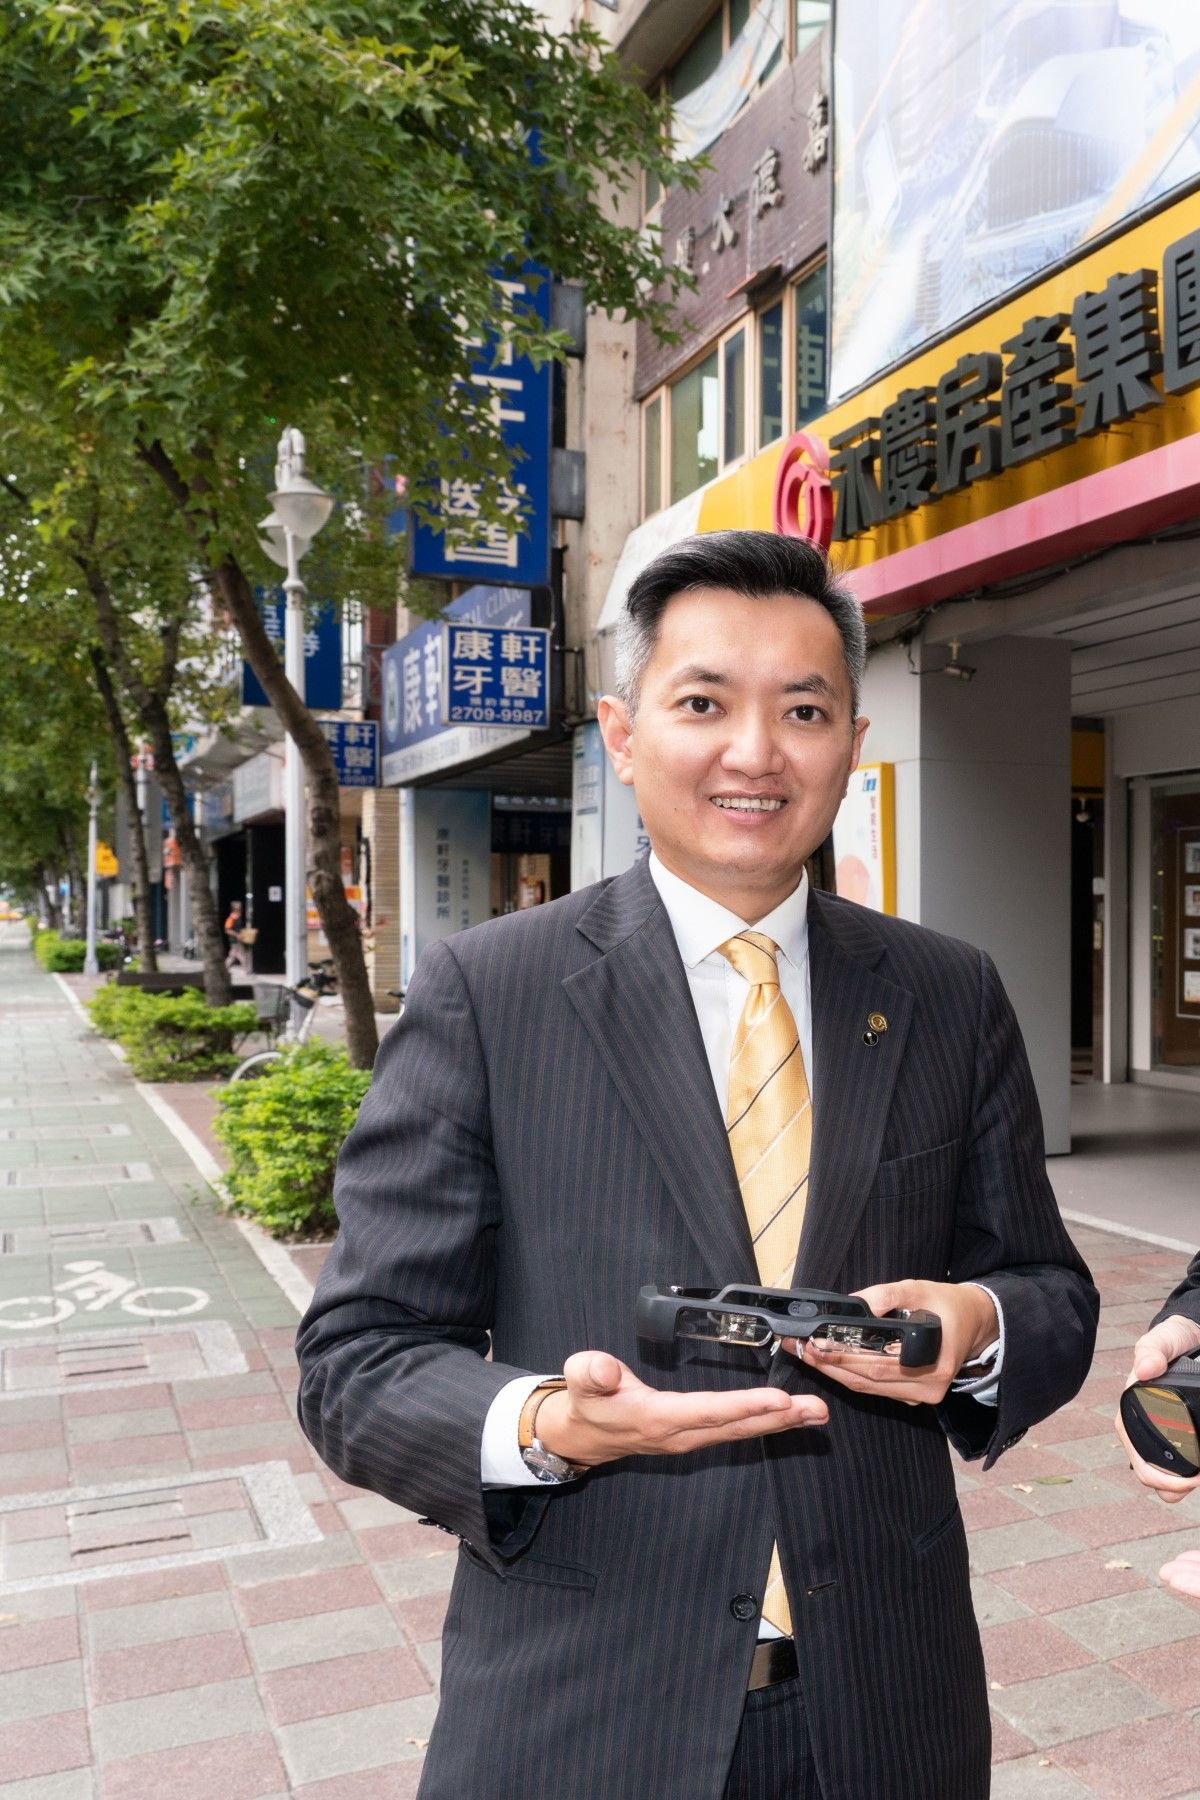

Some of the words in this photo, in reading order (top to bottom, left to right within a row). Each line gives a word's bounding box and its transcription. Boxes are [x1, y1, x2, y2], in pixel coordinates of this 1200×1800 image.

[453, 630, 543, 664] 康軒
[452, 665, 542, 698] 牙醫
[451, 706, 543, 722] 2709-9987
